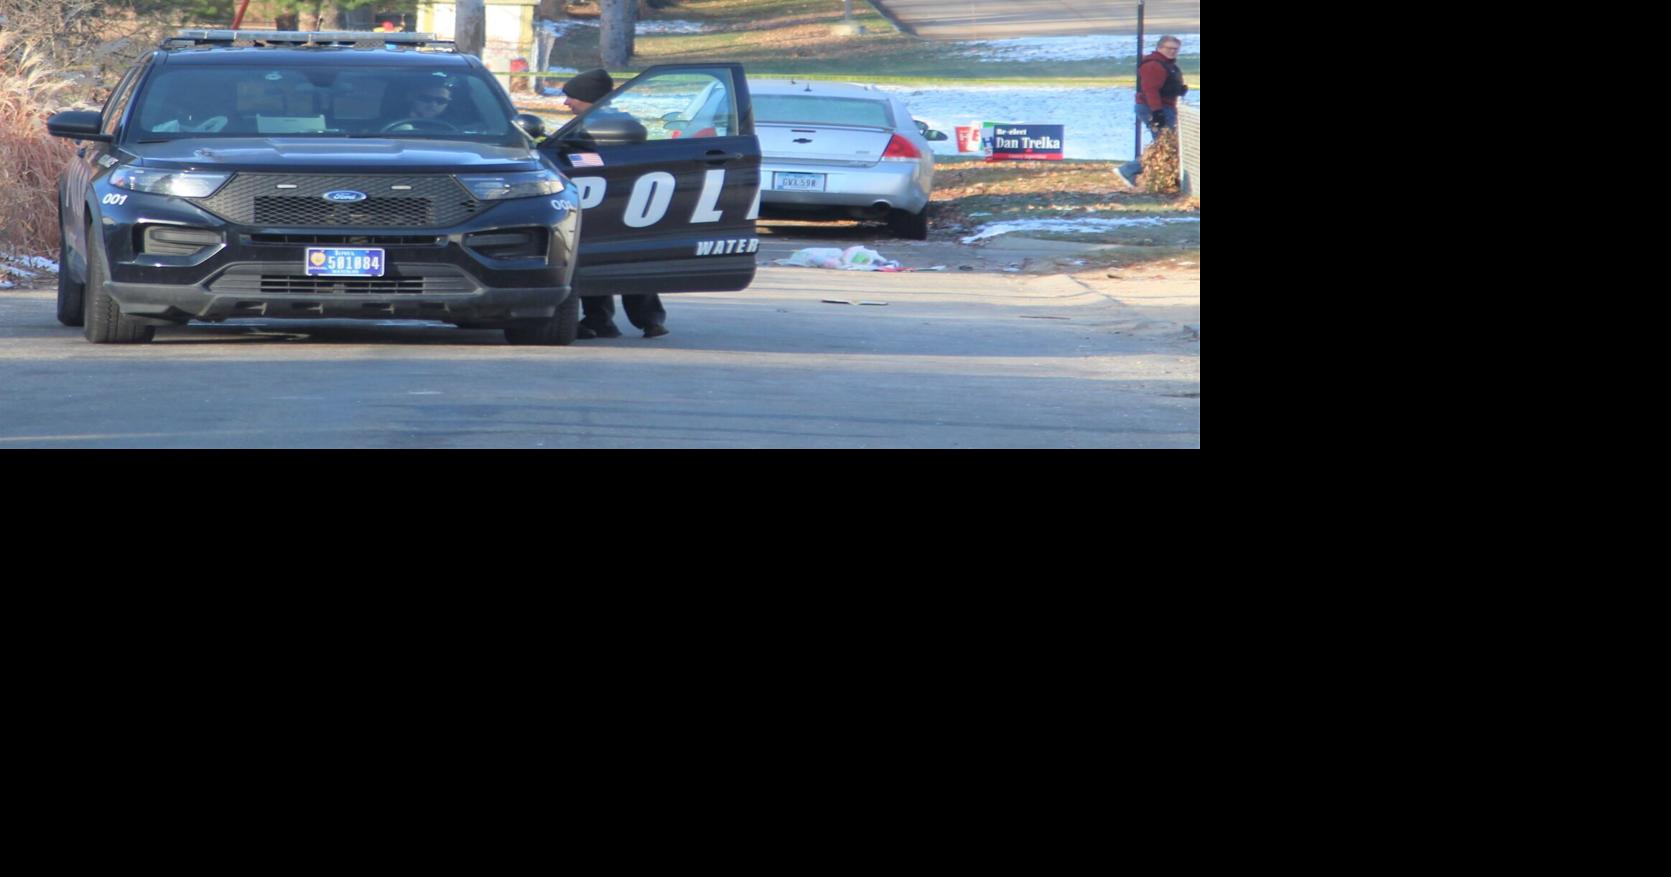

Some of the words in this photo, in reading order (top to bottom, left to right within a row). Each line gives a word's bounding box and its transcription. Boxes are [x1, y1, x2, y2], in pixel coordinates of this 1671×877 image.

[996, 137, 1019, 149] Dan
[1022, 136, 1061, 149] Trelka
[102, 193, 128, 205] 001
